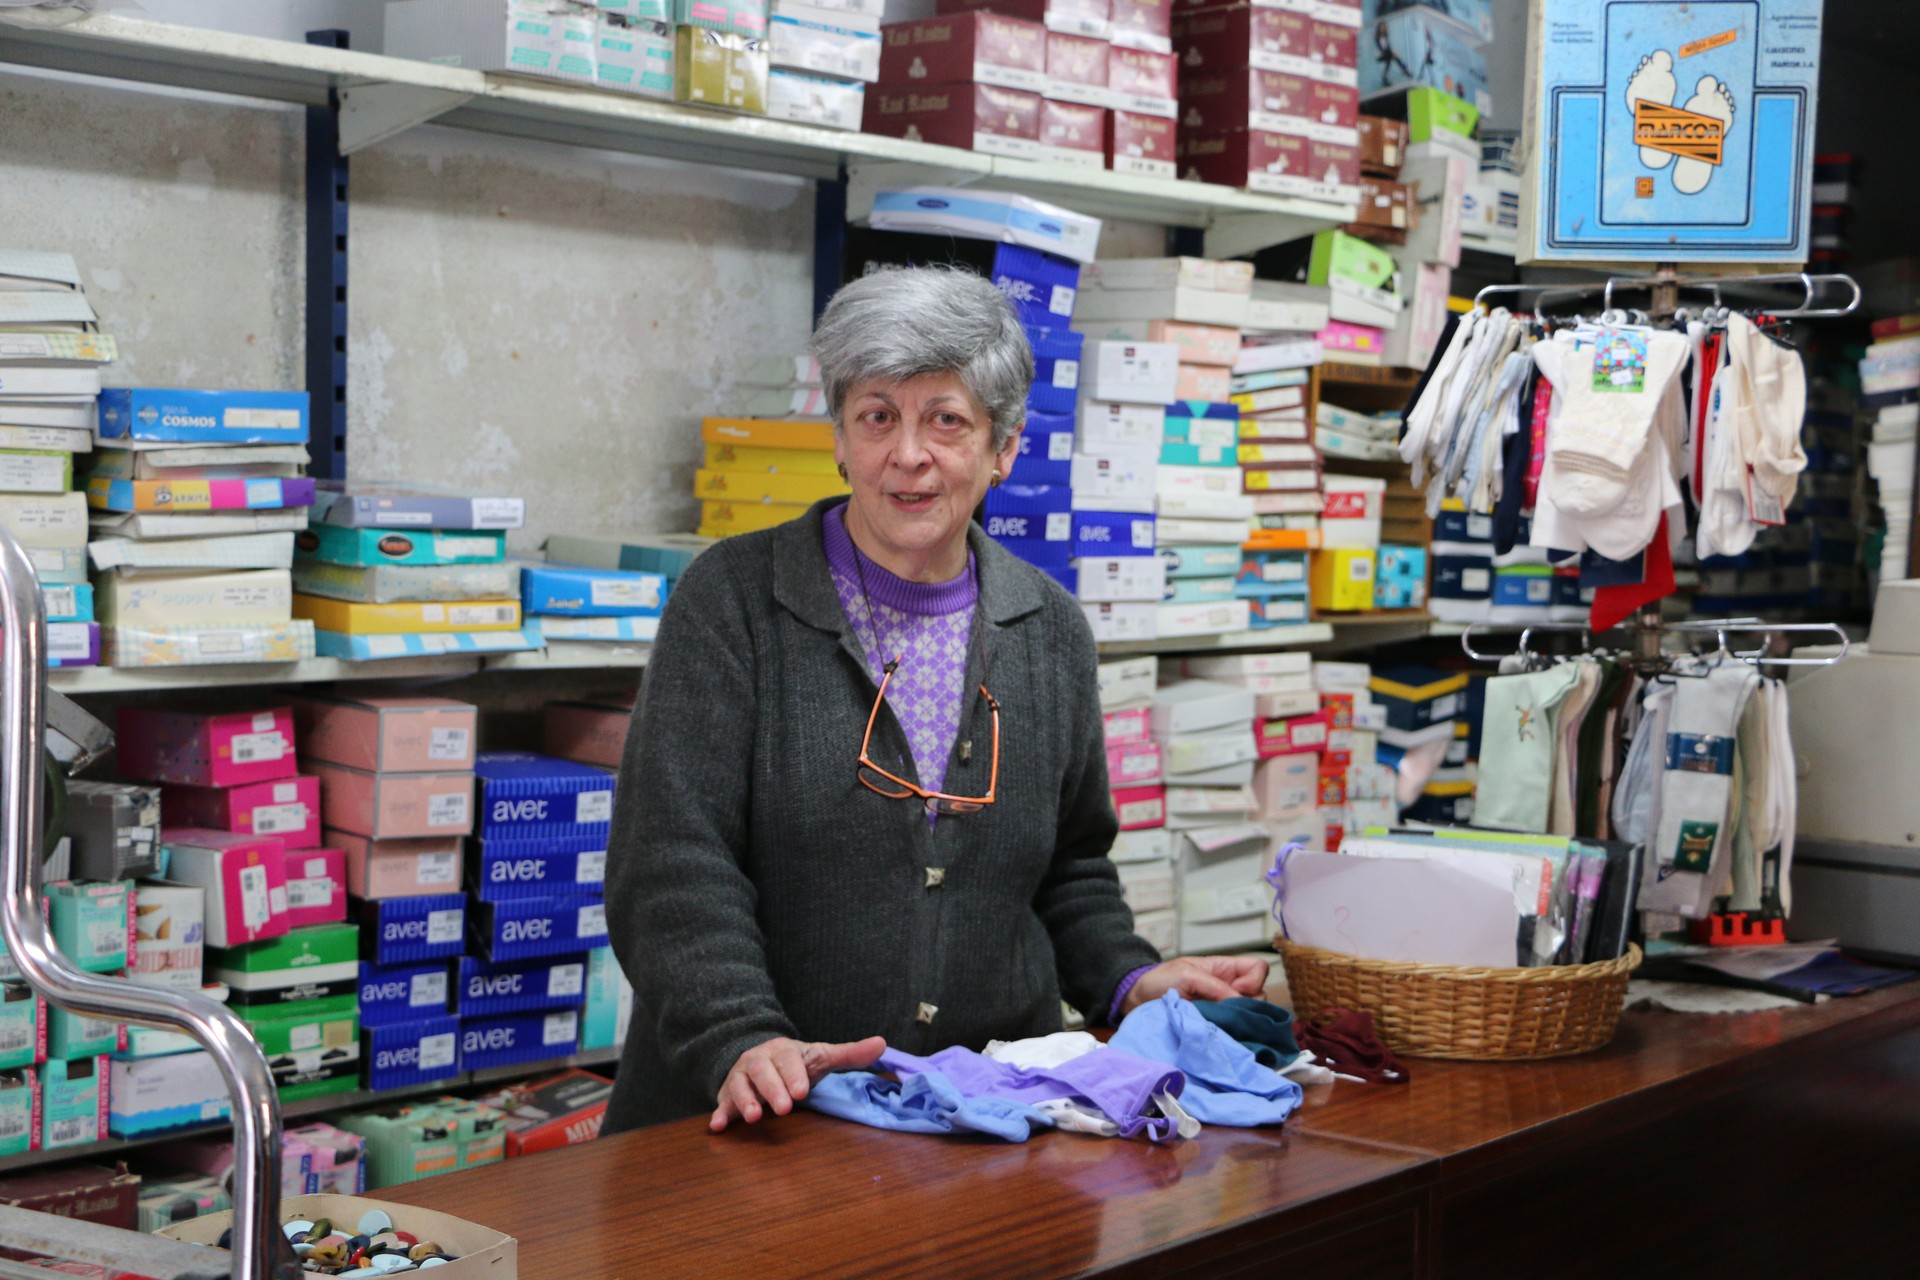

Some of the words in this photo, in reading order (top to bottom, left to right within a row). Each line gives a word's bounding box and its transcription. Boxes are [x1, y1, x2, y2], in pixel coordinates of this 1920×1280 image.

[1637, 122, 1720, 139] MARCOR
[162, 415, 216, 428] COSMOS
[988, 516, 1028, 536] avet
[1079, 525, 1112, 542] avet
[493, 799, 548, 823] avet
[491, 859, 546, 883] avet
[384, 920, 427, 941] avet
[501, 918, 552, 943] avet
[361, 981, 408, 1003] avet
[468, 974, 523, 998] avet
[463, 1027, 516, 1053] avet
[376, 1047, 419, 1069] avet
